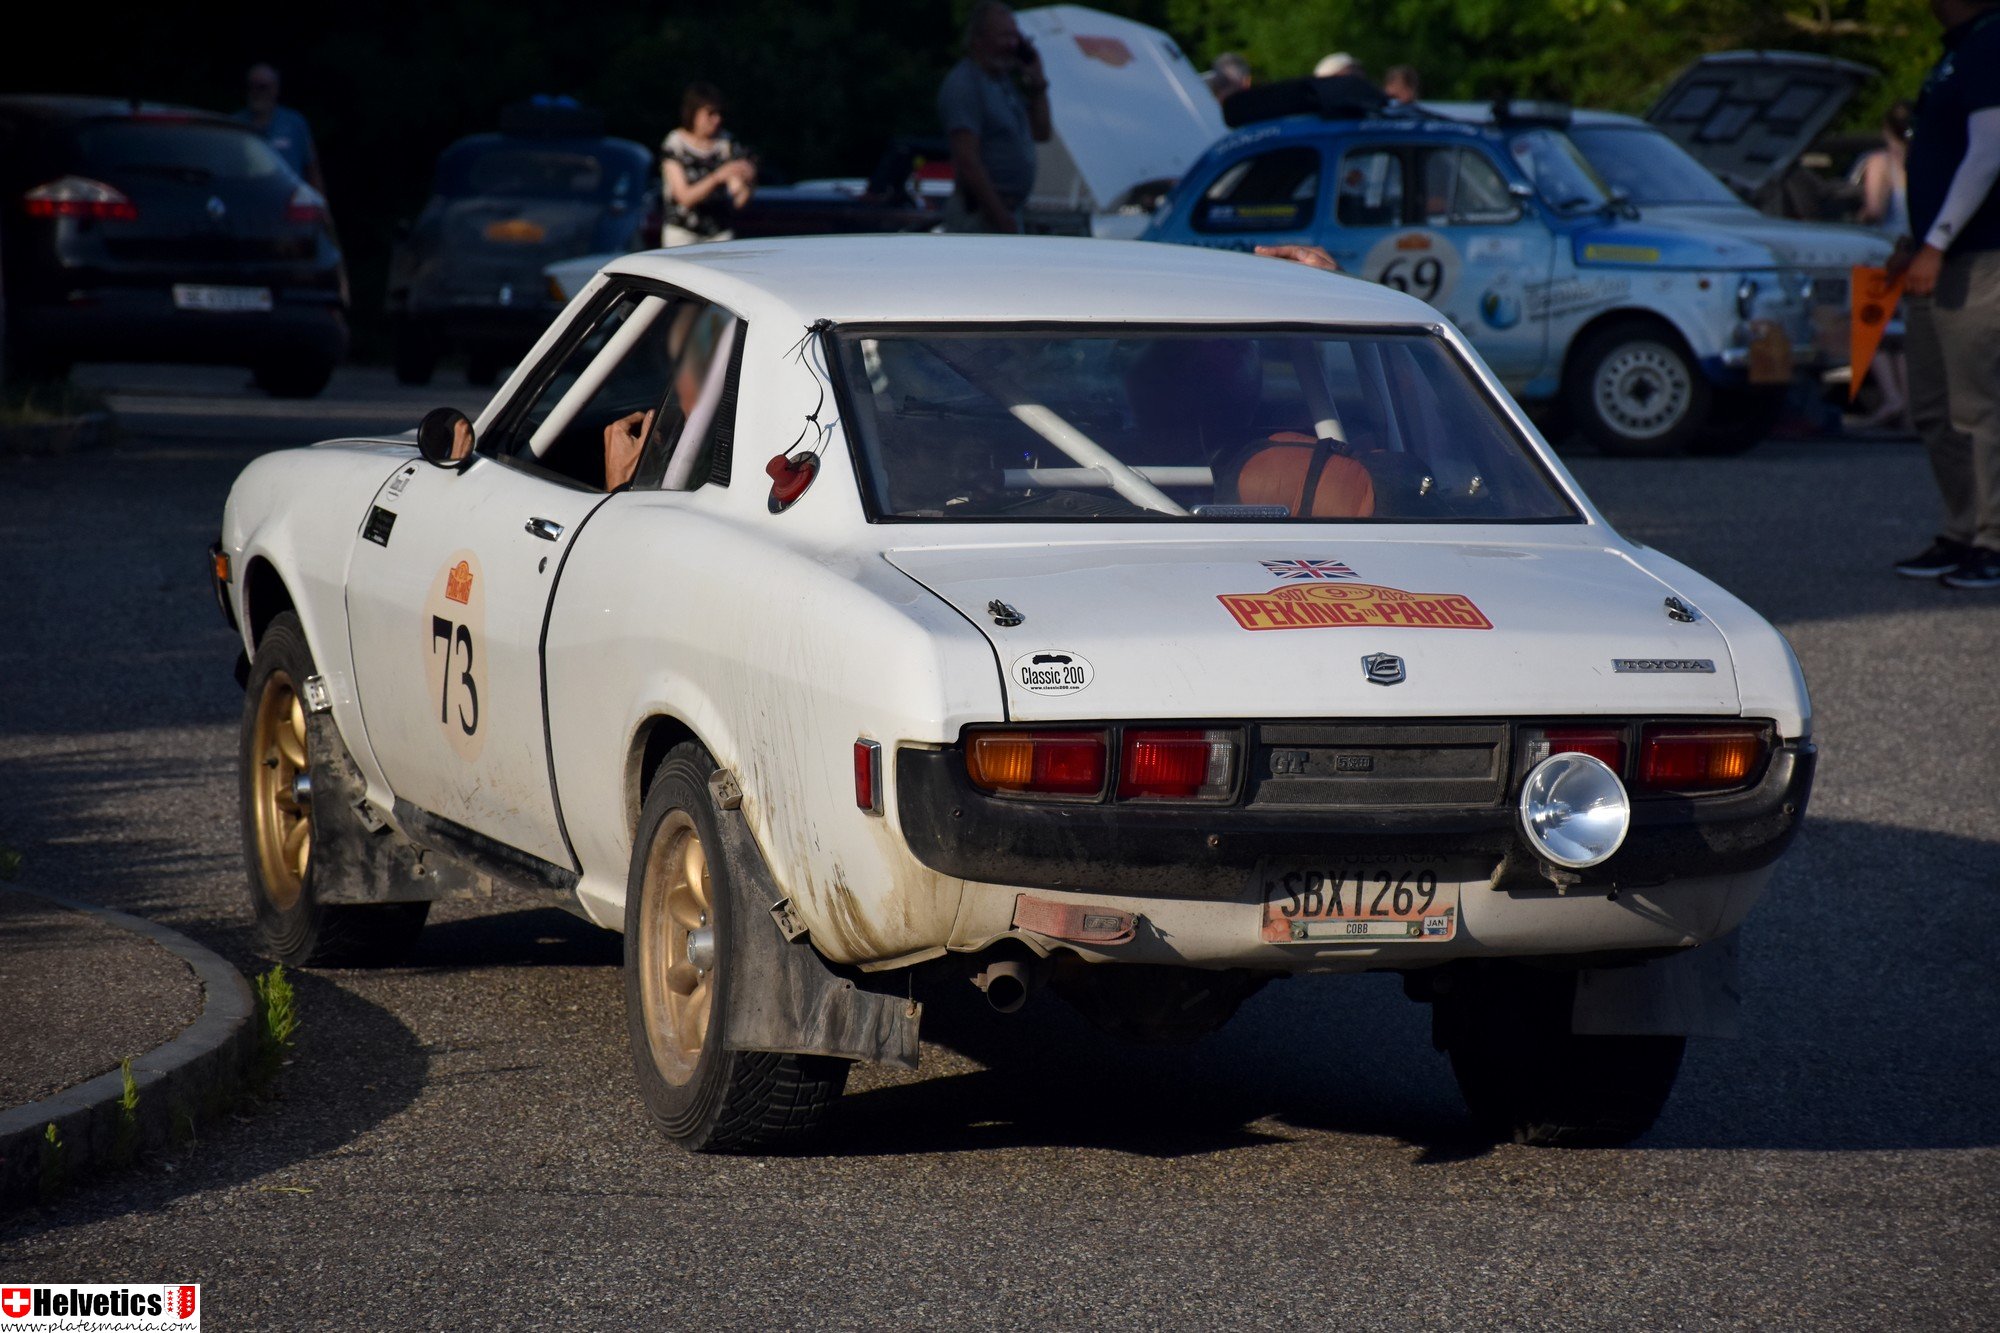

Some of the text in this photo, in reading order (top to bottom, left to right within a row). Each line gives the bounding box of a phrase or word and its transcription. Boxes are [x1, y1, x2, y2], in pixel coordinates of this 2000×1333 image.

[1379, 256, 1444, 300] 69
[1274, 588, 1309, 601] 1907
[1228, 598, 1483, 626] PEKING TO PARIS
[433, 615, 479, 736] 73
[1022, 666, 1085, 685] Classic 200
[1623, 660, 1705, 670] TOYOTA
[1269, 751, 1310, 774] GT
[1280, 869, 1438, 918] SBX1269
[1346, 923, 1368, 934] COBB
[1427, 919, 1444, 927] JAN
